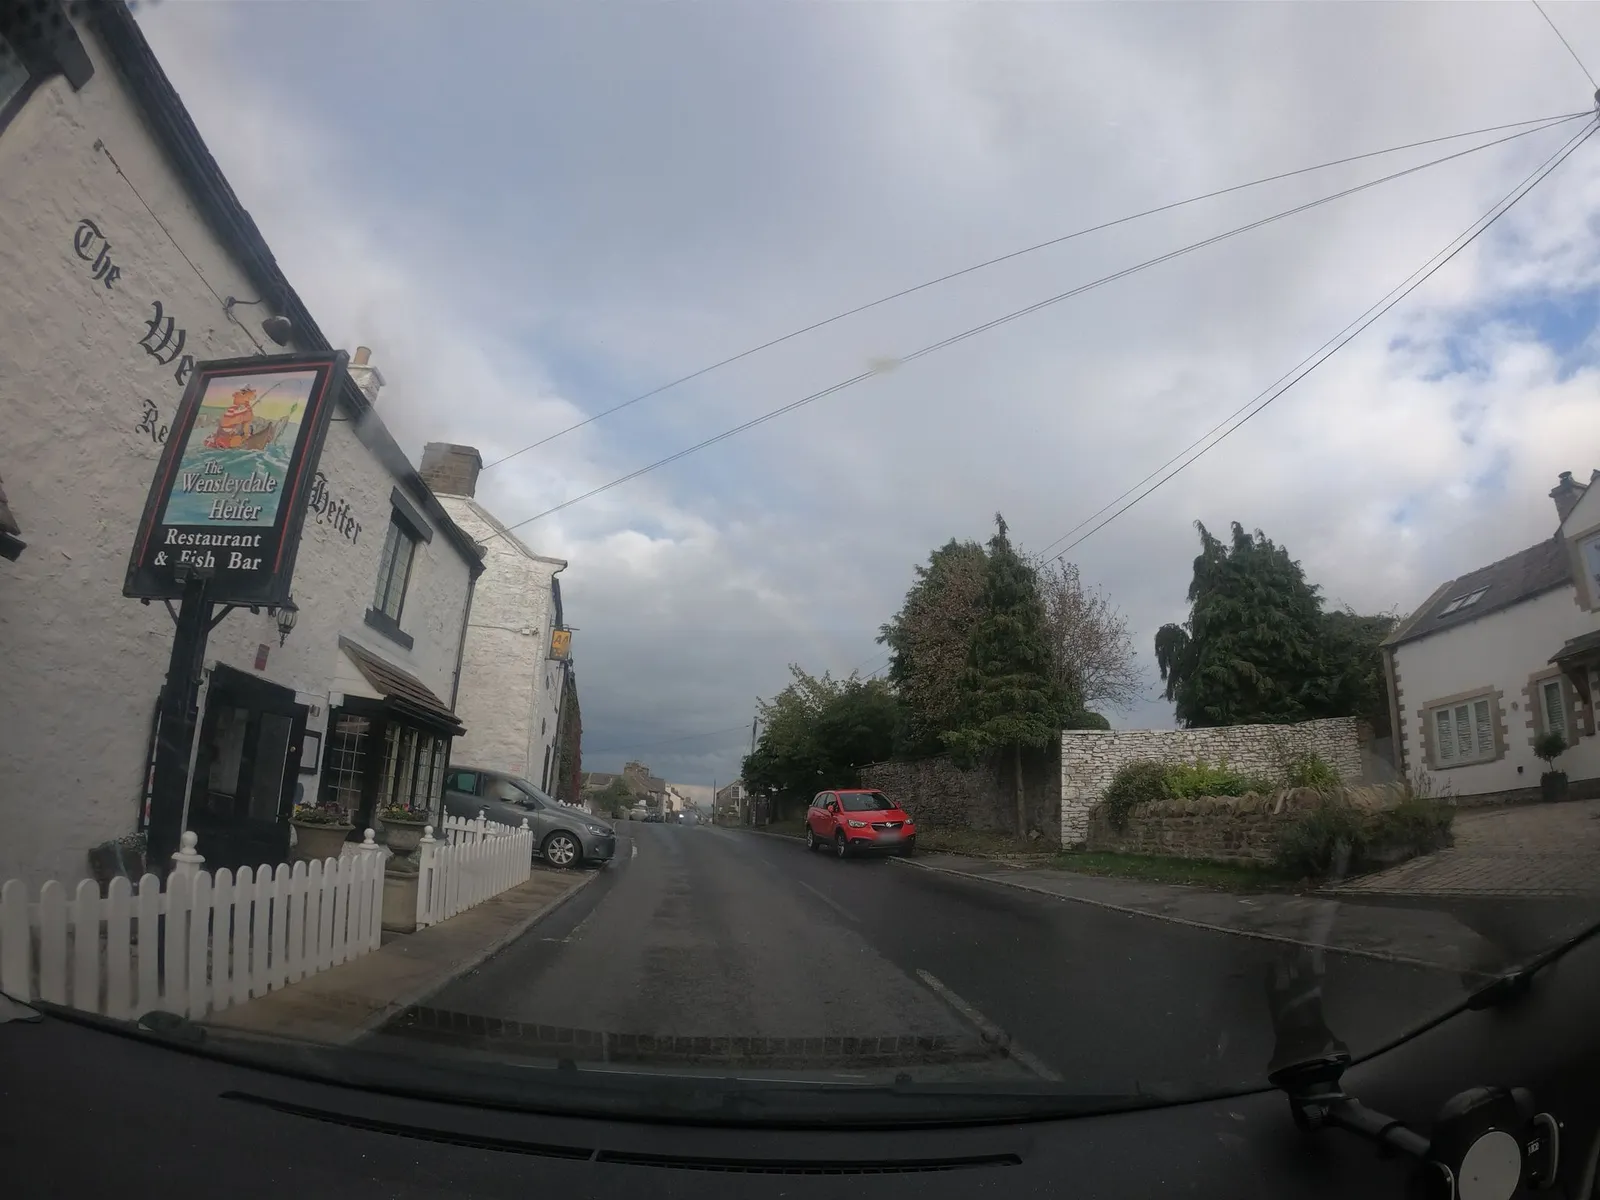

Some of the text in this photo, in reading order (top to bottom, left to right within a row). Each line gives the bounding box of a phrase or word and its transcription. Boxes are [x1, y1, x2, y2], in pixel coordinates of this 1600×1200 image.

[74, 219, 362, 544] The Heifer
[204, 461, 223, 475] The
[182, 472, 277, 498] Wensleydale
[208, 499, 262, 520] Heifer
[164, 528, 261, 547] Restaurant
[154, 550, 262, 570] & Fish Bar
